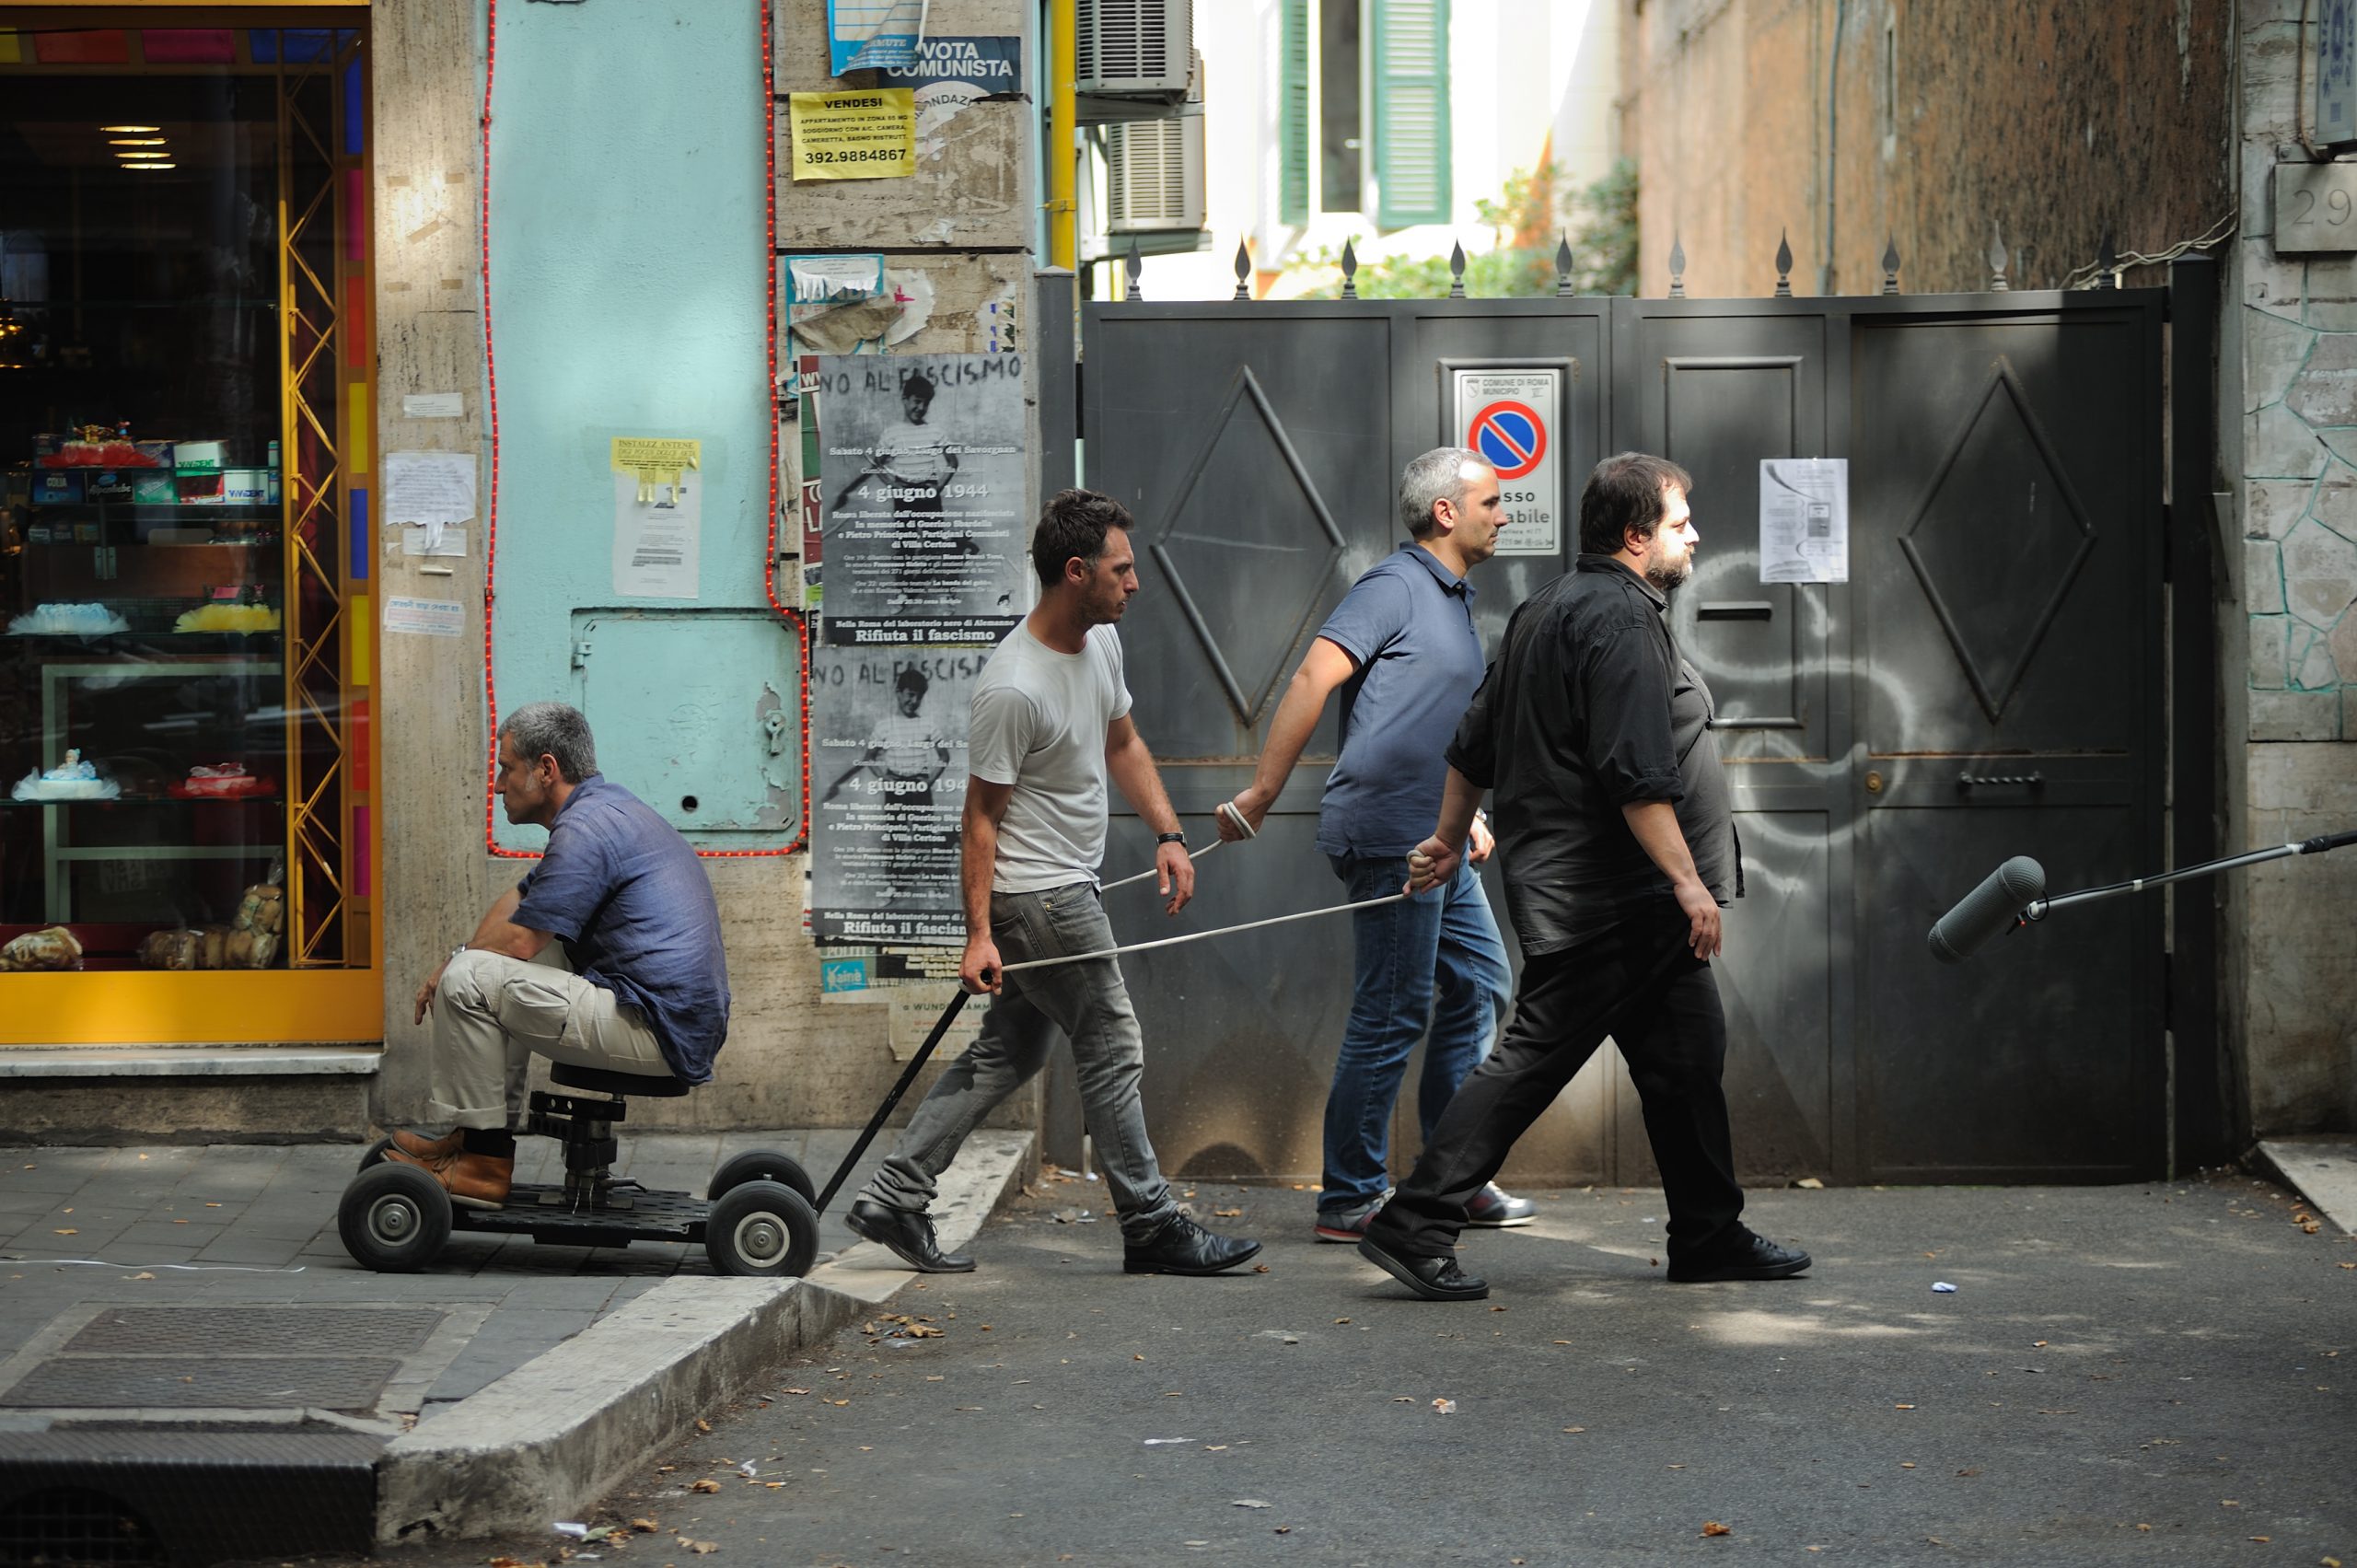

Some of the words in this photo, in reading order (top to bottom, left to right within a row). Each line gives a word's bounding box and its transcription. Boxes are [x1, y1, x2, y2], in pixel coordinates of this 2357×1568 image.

[922, 42, 979, 59] VOTA
[887, 60, 1014, 77] COMUNISTA
[824, 98, 882, 109] VENDESI
[805, 149, 906, 164] 392.9884867
[2293, 189, 2351, 226] 29
[820, 372, 850, 394] NO
[865, 370, 889, 391] AL
[1482, 378, 1515, 387] COMUNE
[1517, 378, 1526, 387] DI
[1527, 378, 1550, 387] ROMA
[830, 447, 864, 456] Sabato
[858, 485, 870, 498] 4
[877, 484, 938, 502] giugno
[943, 484, 990, 498] 1944
[1501, 492, 1536, 504] sso
[1506, 509, 1550, 523] abile
[866, 520, 905, 528] memoria
[906, 520, 916, 528] di
[891, 540, 901, 549] di
[902, 540, 923, 549] Villa
[858, 620, 882, 628] Roma
[963, 619, 973, 627] di
[855, 629, 910, 642] Rifiuta
[911, 629, 924, 642] il
[927, 628, 995, 642] fascismo
[814, 664, 844, 686] NO
[860, 662, 886, 684] AL
[894, 655, 988, 683] FSCIS
[821, 738, 856, 747] Sabato
[858, 738, 866, 747] 4
[937, 739, 954, 749] dei
[849, 777, 862, 791] 4
[867, 777, 929, 796] giugno
[935, 778, 967, 793] 194
[823, 802, 849, 810] Roma
[849, 802, 883, 810] liberata
[896, 813, 907, 821] di
[881, 833, 891, 842] di
[891, 833, 912, 842] Villa
[913, 833, 947, 842] Certosa
[885, 912, 930, 921] laboratorio
[843, 921, 897, 934] Rifiuta
[900, 921, 911, 935] il
